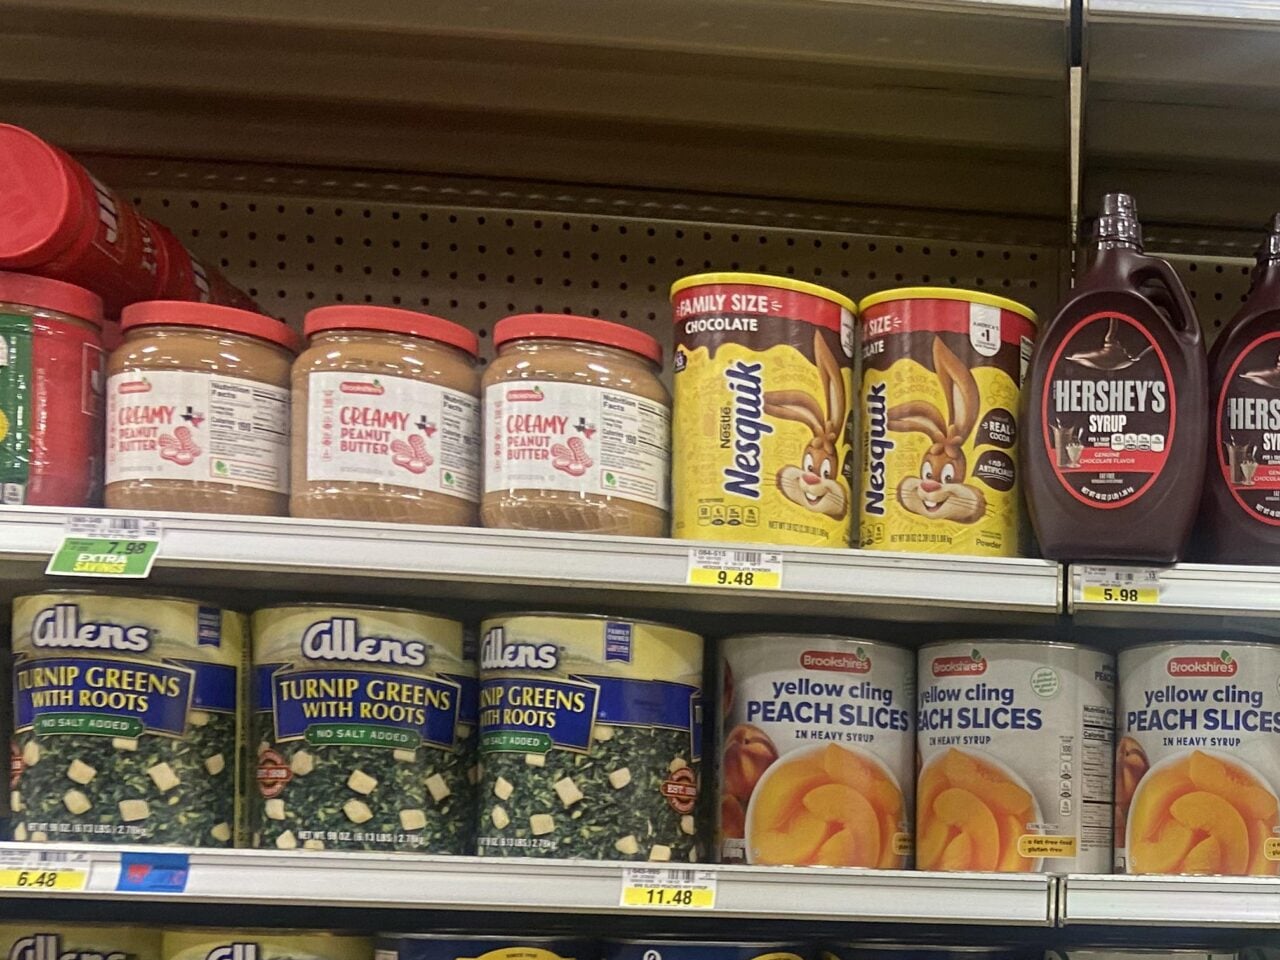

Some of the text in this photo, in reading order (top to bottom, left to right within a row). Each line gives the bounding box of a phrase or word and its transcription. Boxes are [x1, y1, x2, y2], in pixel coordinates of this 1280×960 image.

[680, 294, 769, 317] FAMILY SIZE
[685, 318, 758, 334] CHOCOLATE
[1056, 380, 1166, 413] HERSHEY'S
[119, 405, 175, 425] CREAMY
[340, 406, 410, 431] CREAMY
[1089, 414, 1127, 433] SYRUP
[119, 426, 157, 440] PEANUT
[340, 427, 391, 443] PEANUT
[725, 361, 773, 498] Nesquik
[119, 440, 156, 453] BUTTER
[340, 440, 389, 455] BUTTER
[865, 383, 895, 514] Nesquik
[107, 541, 147, 555] 7.98
[76, 553, 128, 564] EXTRA
[717, 571, 754, 586] 9.48
[1104, 588, 1138, 602] 5.98
[17, 666, 180, 698] TURNIP GREENS
[773, 679, 893, 704] yellow cling
[31, 690, 148, 712] WITH ROOTS
[280, 678, 450, 711] TURNIP GREENS
[508, 687, 585, 713] GREENS
[965, 684, 1014, 704] cling
[303, 701, 425, 725] WITH ROOTS
[503, 708, 556, 728] ROOTS
[746, 701, 908, 731] PEACH SLICES
[957, 708, 1042, 731] SLICES
[1127, 709, 1198, 732] PEACH
[316, 729, 408, 742] NO SALT ADDED
[796, 730, 874, 743] IN HEAVY SYRUP
[938, 736, 991, 746] HEAVY SYRUP
[1163, 737, 1241, 747] IN HEAVY SYRUP
[17, 872, 57, 887] 6.48
[646, 889, 692, 905] 11.48
